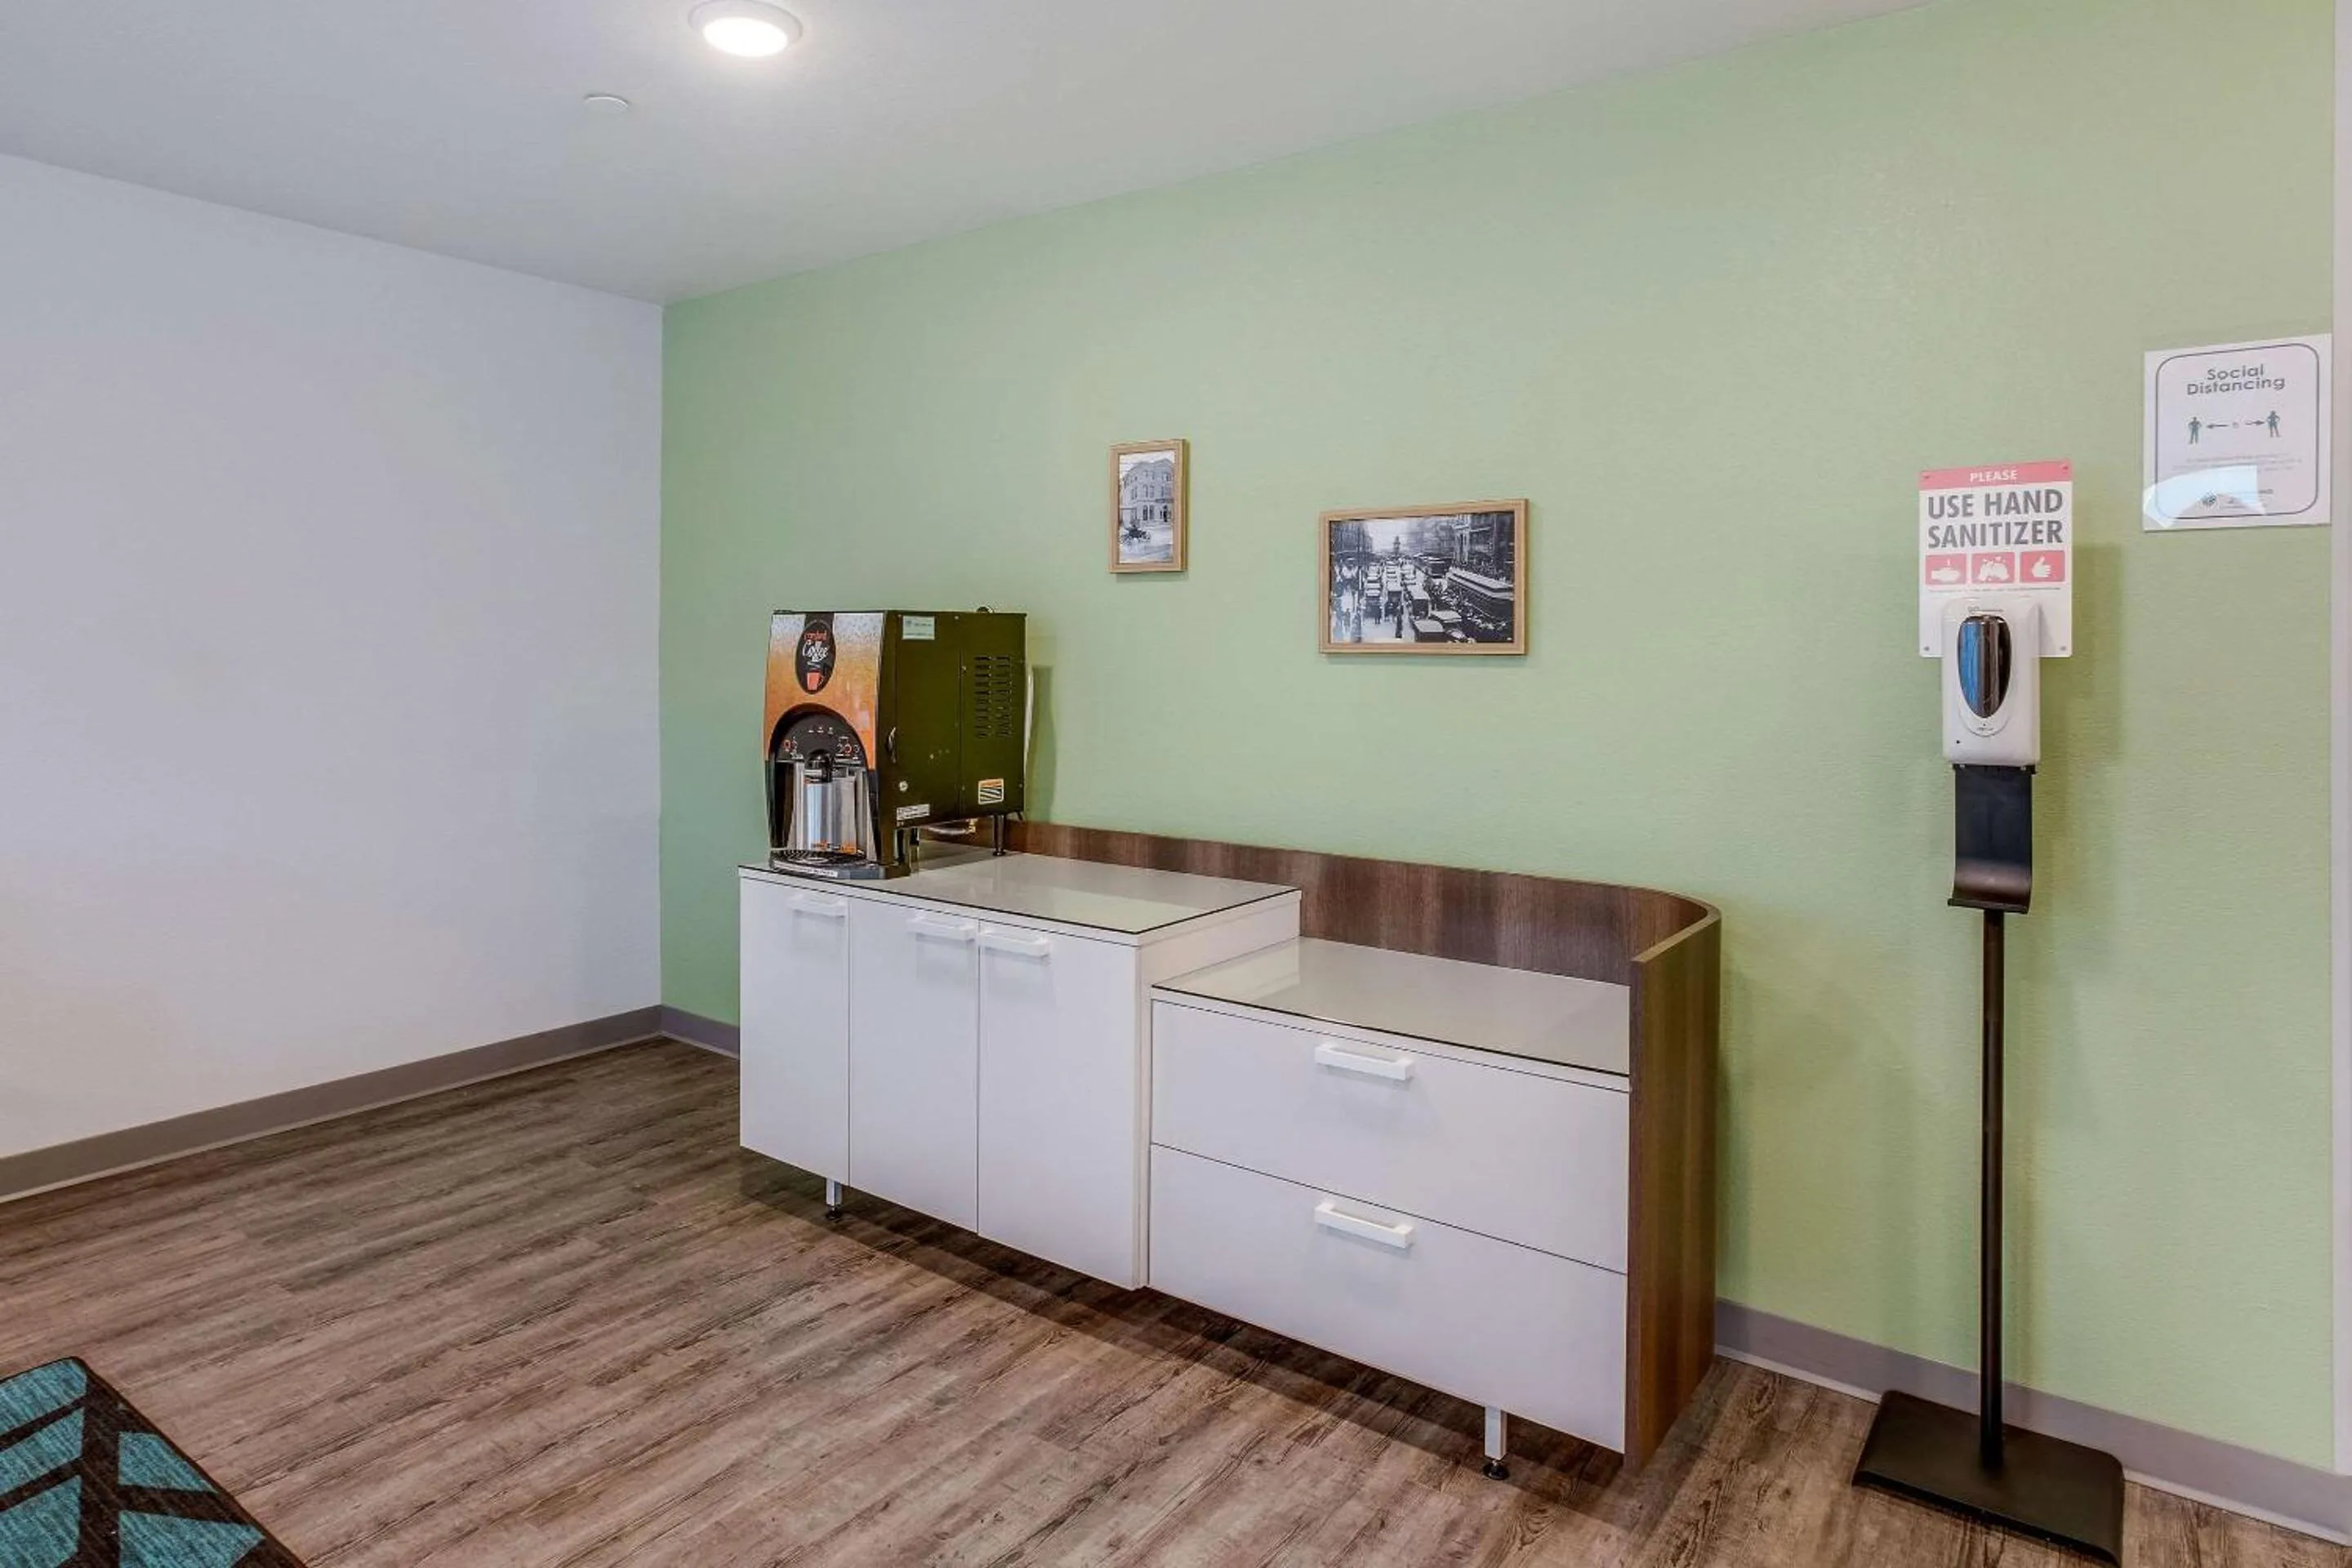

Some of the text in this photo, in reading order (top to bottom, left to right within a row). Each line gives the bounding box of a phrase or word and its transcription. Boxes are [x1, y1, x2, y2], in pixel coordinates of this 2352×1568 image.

[2207, 364, 2264, 380] Social
[2187, 378, 2285, 395] Distancing
[1970, 470, 2018, 483] PLEASE
[1928, 489, 2063, 519] USE HAND
[1928, 520, 2063, 549] SANITIZER
